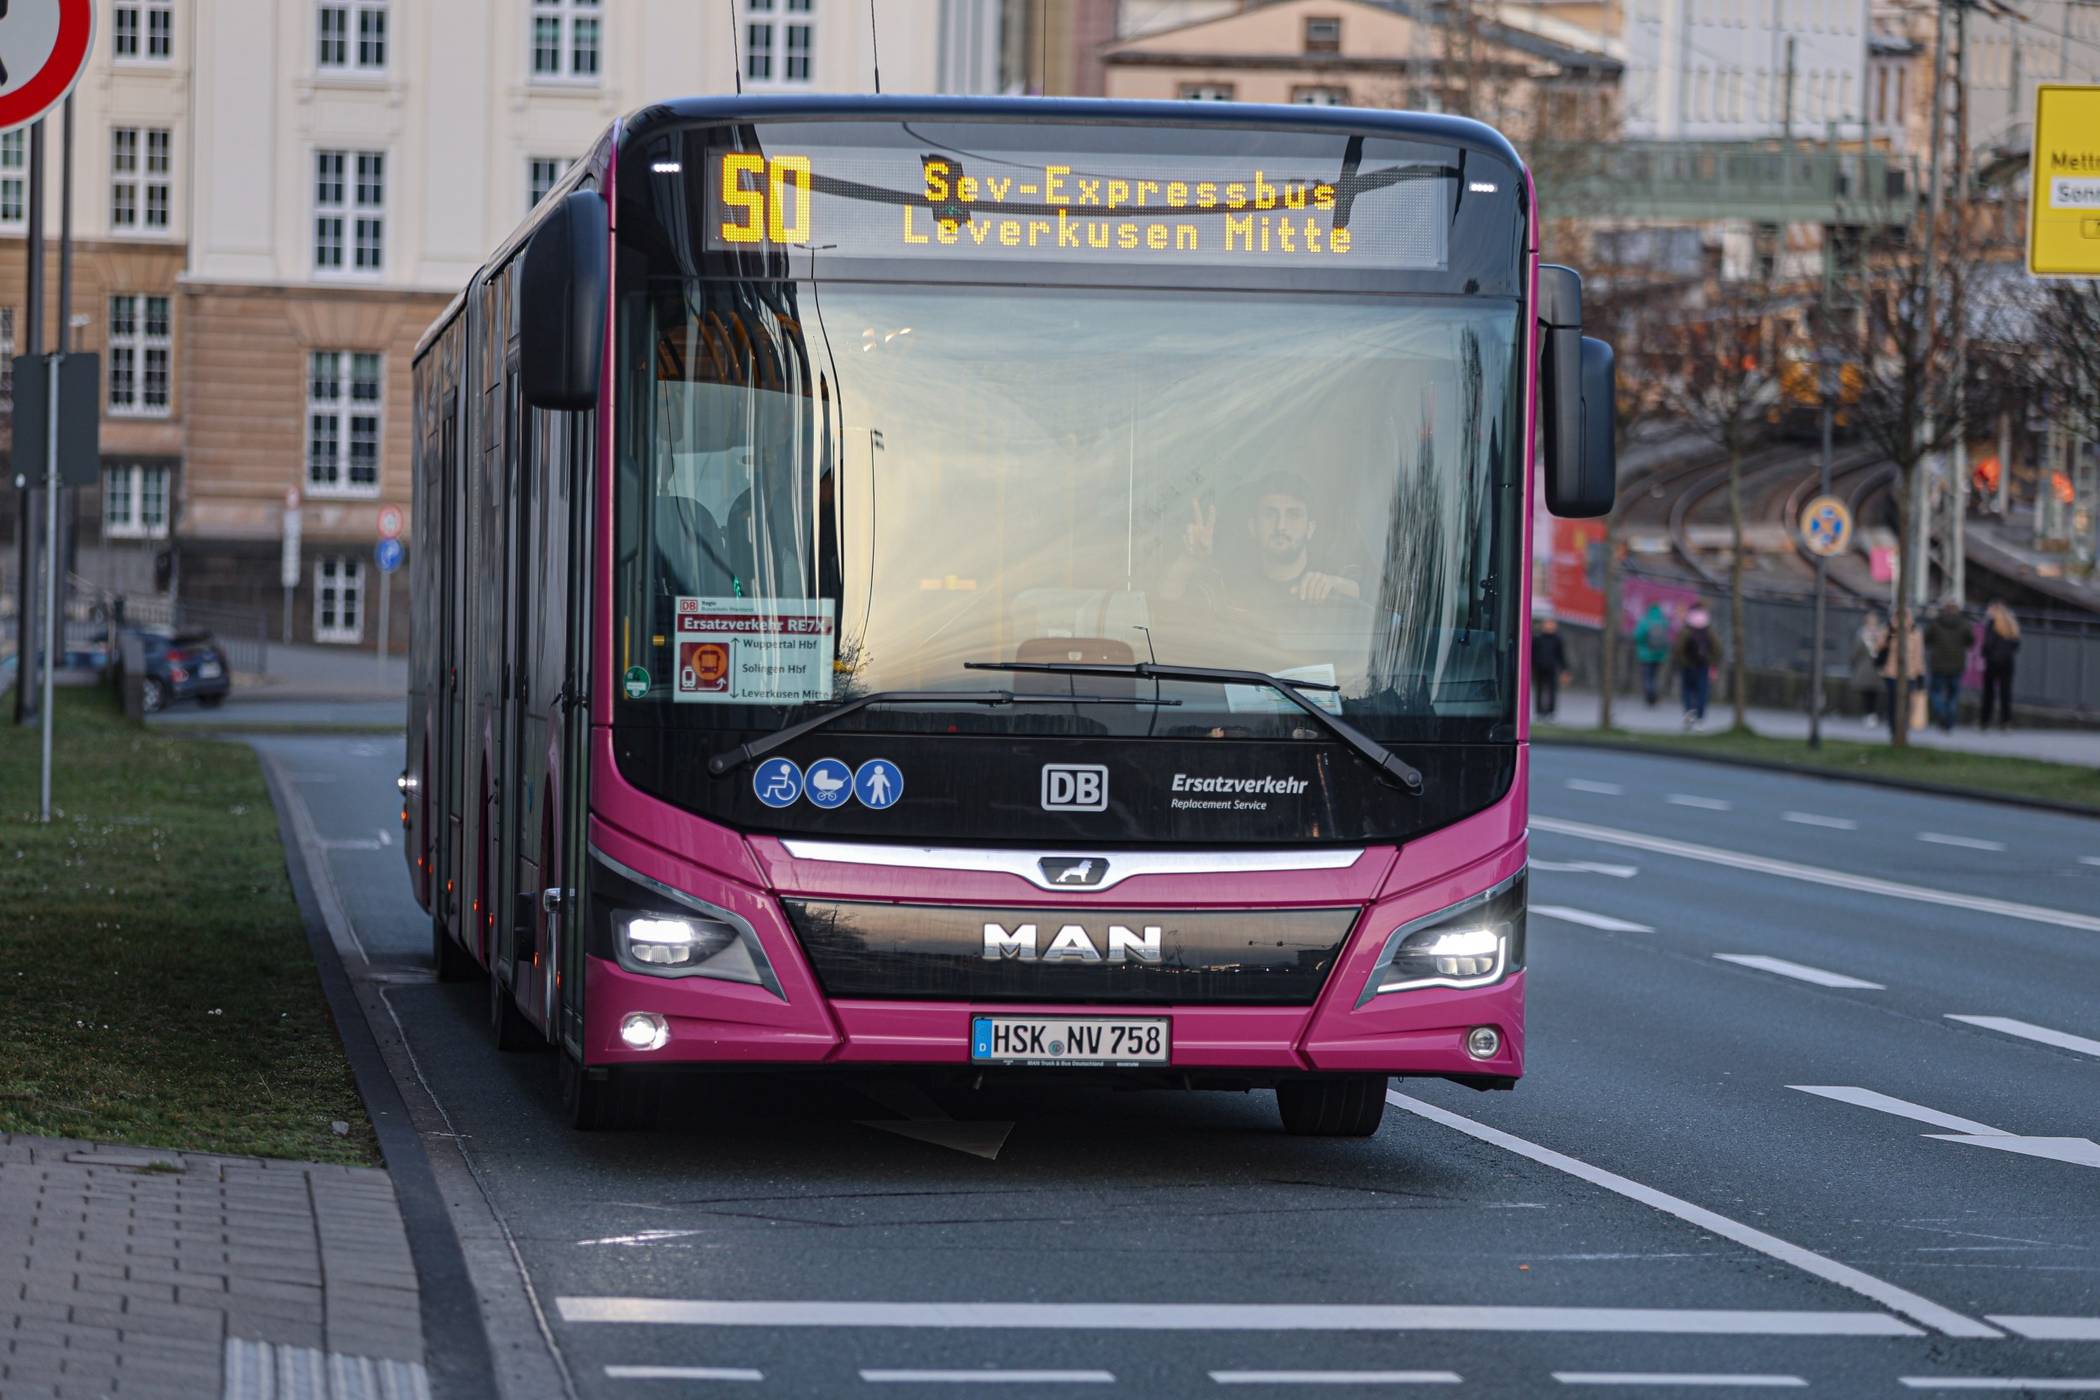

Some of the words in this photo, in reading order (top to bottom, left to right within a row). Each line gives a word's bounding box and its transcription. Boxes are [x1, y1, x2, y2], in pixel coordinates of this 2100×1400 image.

[924, 161, 1336, 211] Sev-Expressbus
[904, 204, 1198, 250] Leverkusen
[1224, 212, 1351, 253] Mitte
[682, 601, 697, 610] DB
[684, 618, 783, 632] Ersatzverkehr
[788, 620, 824, 632] RE7X
[743, 639, 795, 650] Wuppertal
[798, 640, 817, 649] Hbf
[742, 664, 785, 675] Solingen
[788, 665, 807, 674] Hbf
[742, 689, 799, 699] Leverkusen
[802, 690, 829, 699] Mitte
[1050, 771, 1100, 804] DB
[1171, 773, 1308, 794] Ersatzverkehr
[1171, 798, 1232, 810] Replacement
[1233, 800, 1267, 810] Service
[982, 923, 1162, 962] MAN
[979, 1043, 987, 1051] D
[993, 1024, 1047, 1053] HSK
[1067, 1026, 1102, 1054] NV
[1110, 1026, 1160, 1054] 758
